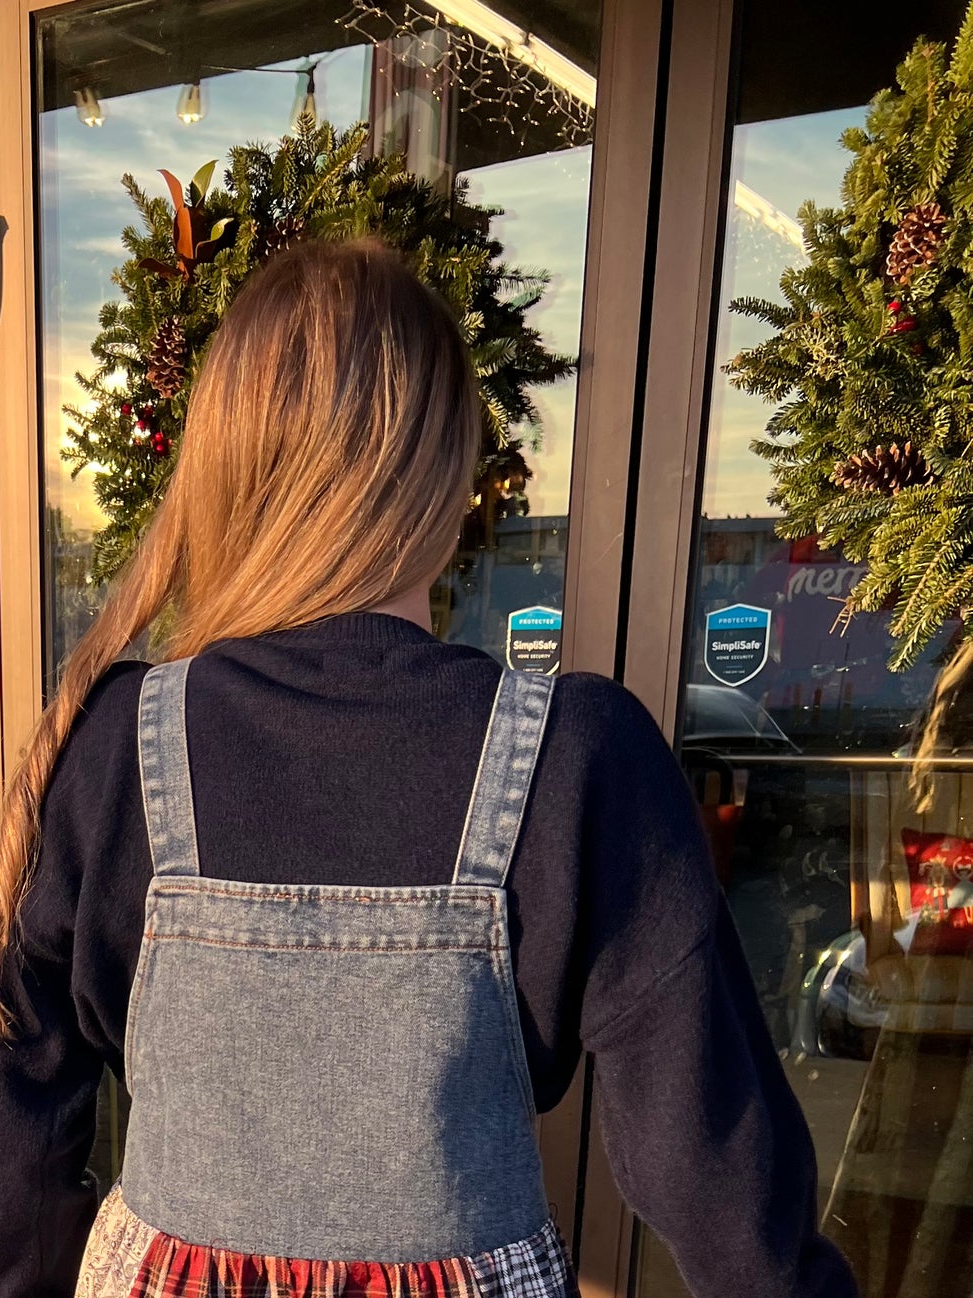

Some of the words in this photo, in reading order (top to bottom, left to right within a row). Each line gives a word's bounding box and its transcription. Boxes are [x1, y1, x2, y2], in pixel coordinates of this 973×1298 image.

[787, 566, 867, 603] merr
[718, 616, 758, 624] PROTECTED
[513, 640, 557, 652] SimpliSafe
[711, 640, 760, 652] SimpliSafe
